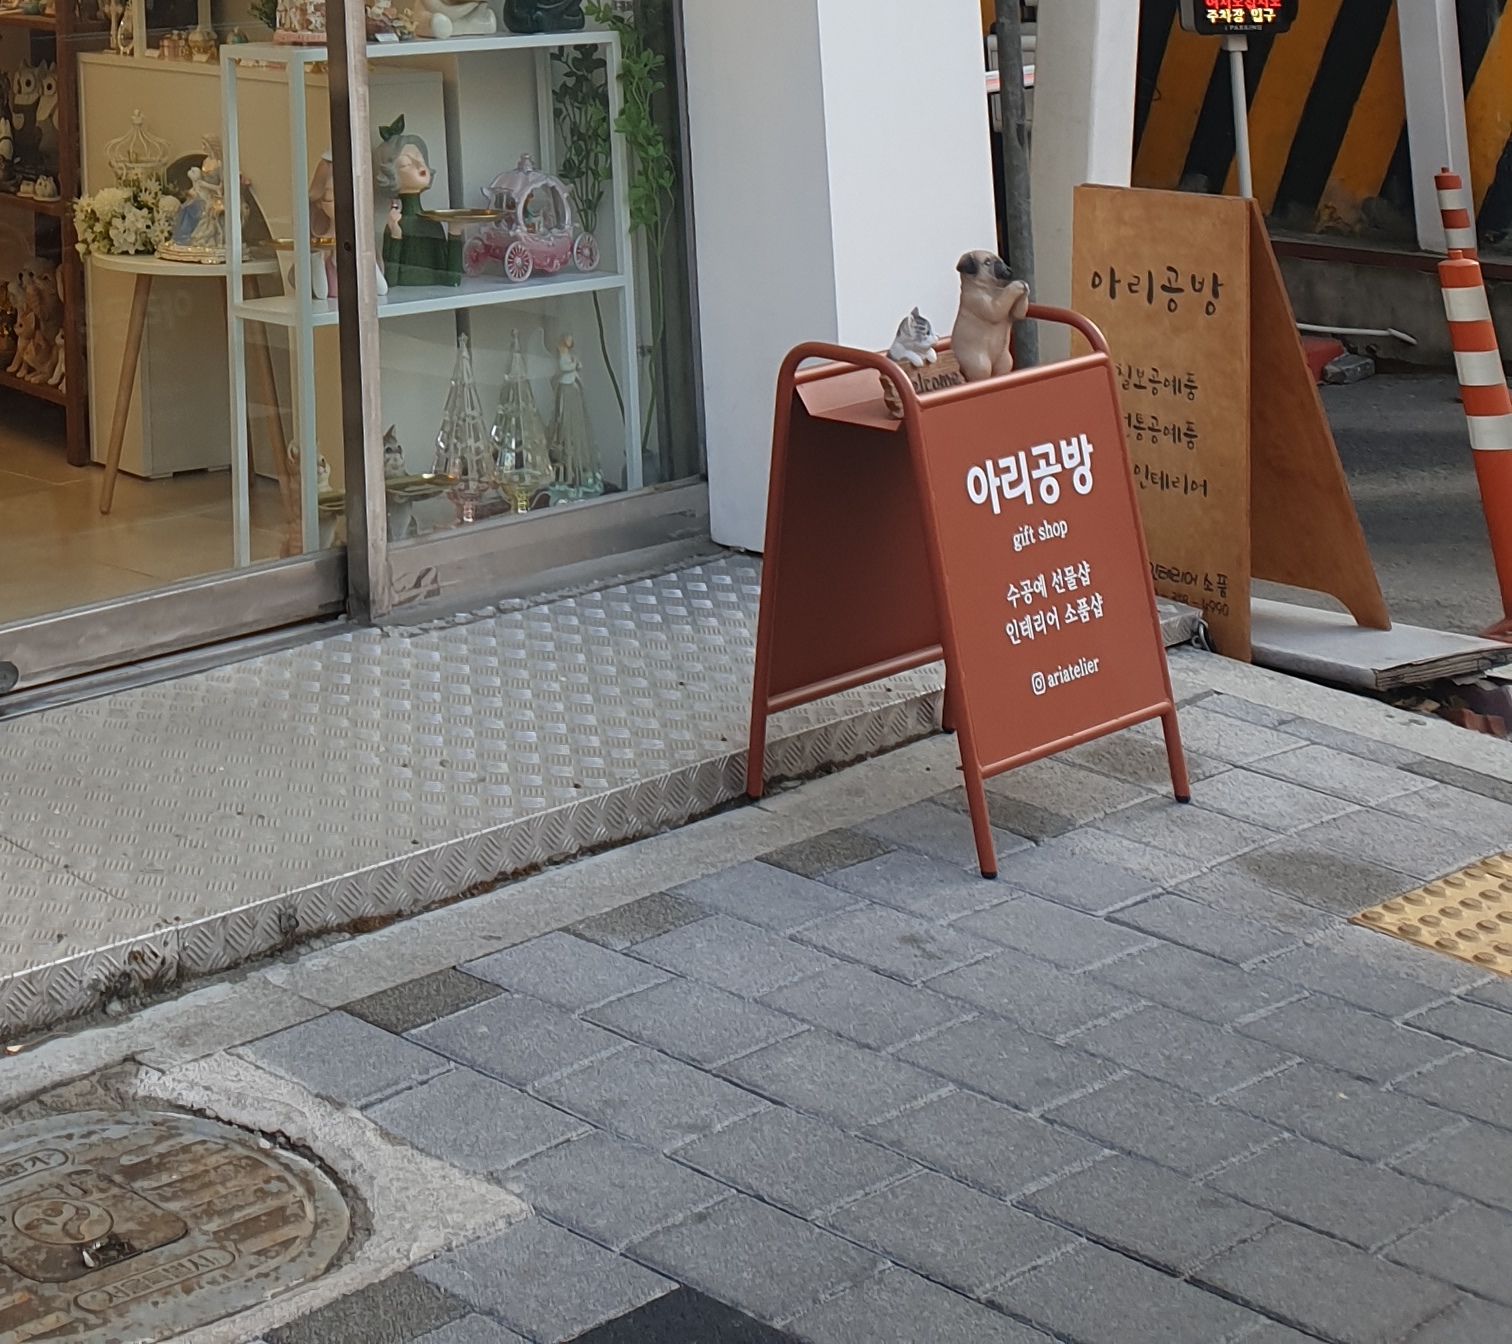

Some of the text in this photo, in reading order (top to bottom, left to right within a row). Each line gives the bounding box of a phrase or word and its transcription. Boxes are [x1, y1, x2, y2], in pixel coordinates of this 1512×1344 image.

[1206, 9, 1276, 23] 주차장 입구
[1091, 265, 1224, 316] 아리공방
[912, 372, 959, 392] elcome
[966, 433, 1094, 514] 아리공방
[1134, 464, 1207, 497] 인테리어
[1013, 519, 1068, 552] gift shop
[1006, 560, 1091, 607] 수공예 선물샵
[1006, 592, 1104, 645] 인테리어 소품샵
[1047, 657, 1100, 688] ariatelier
